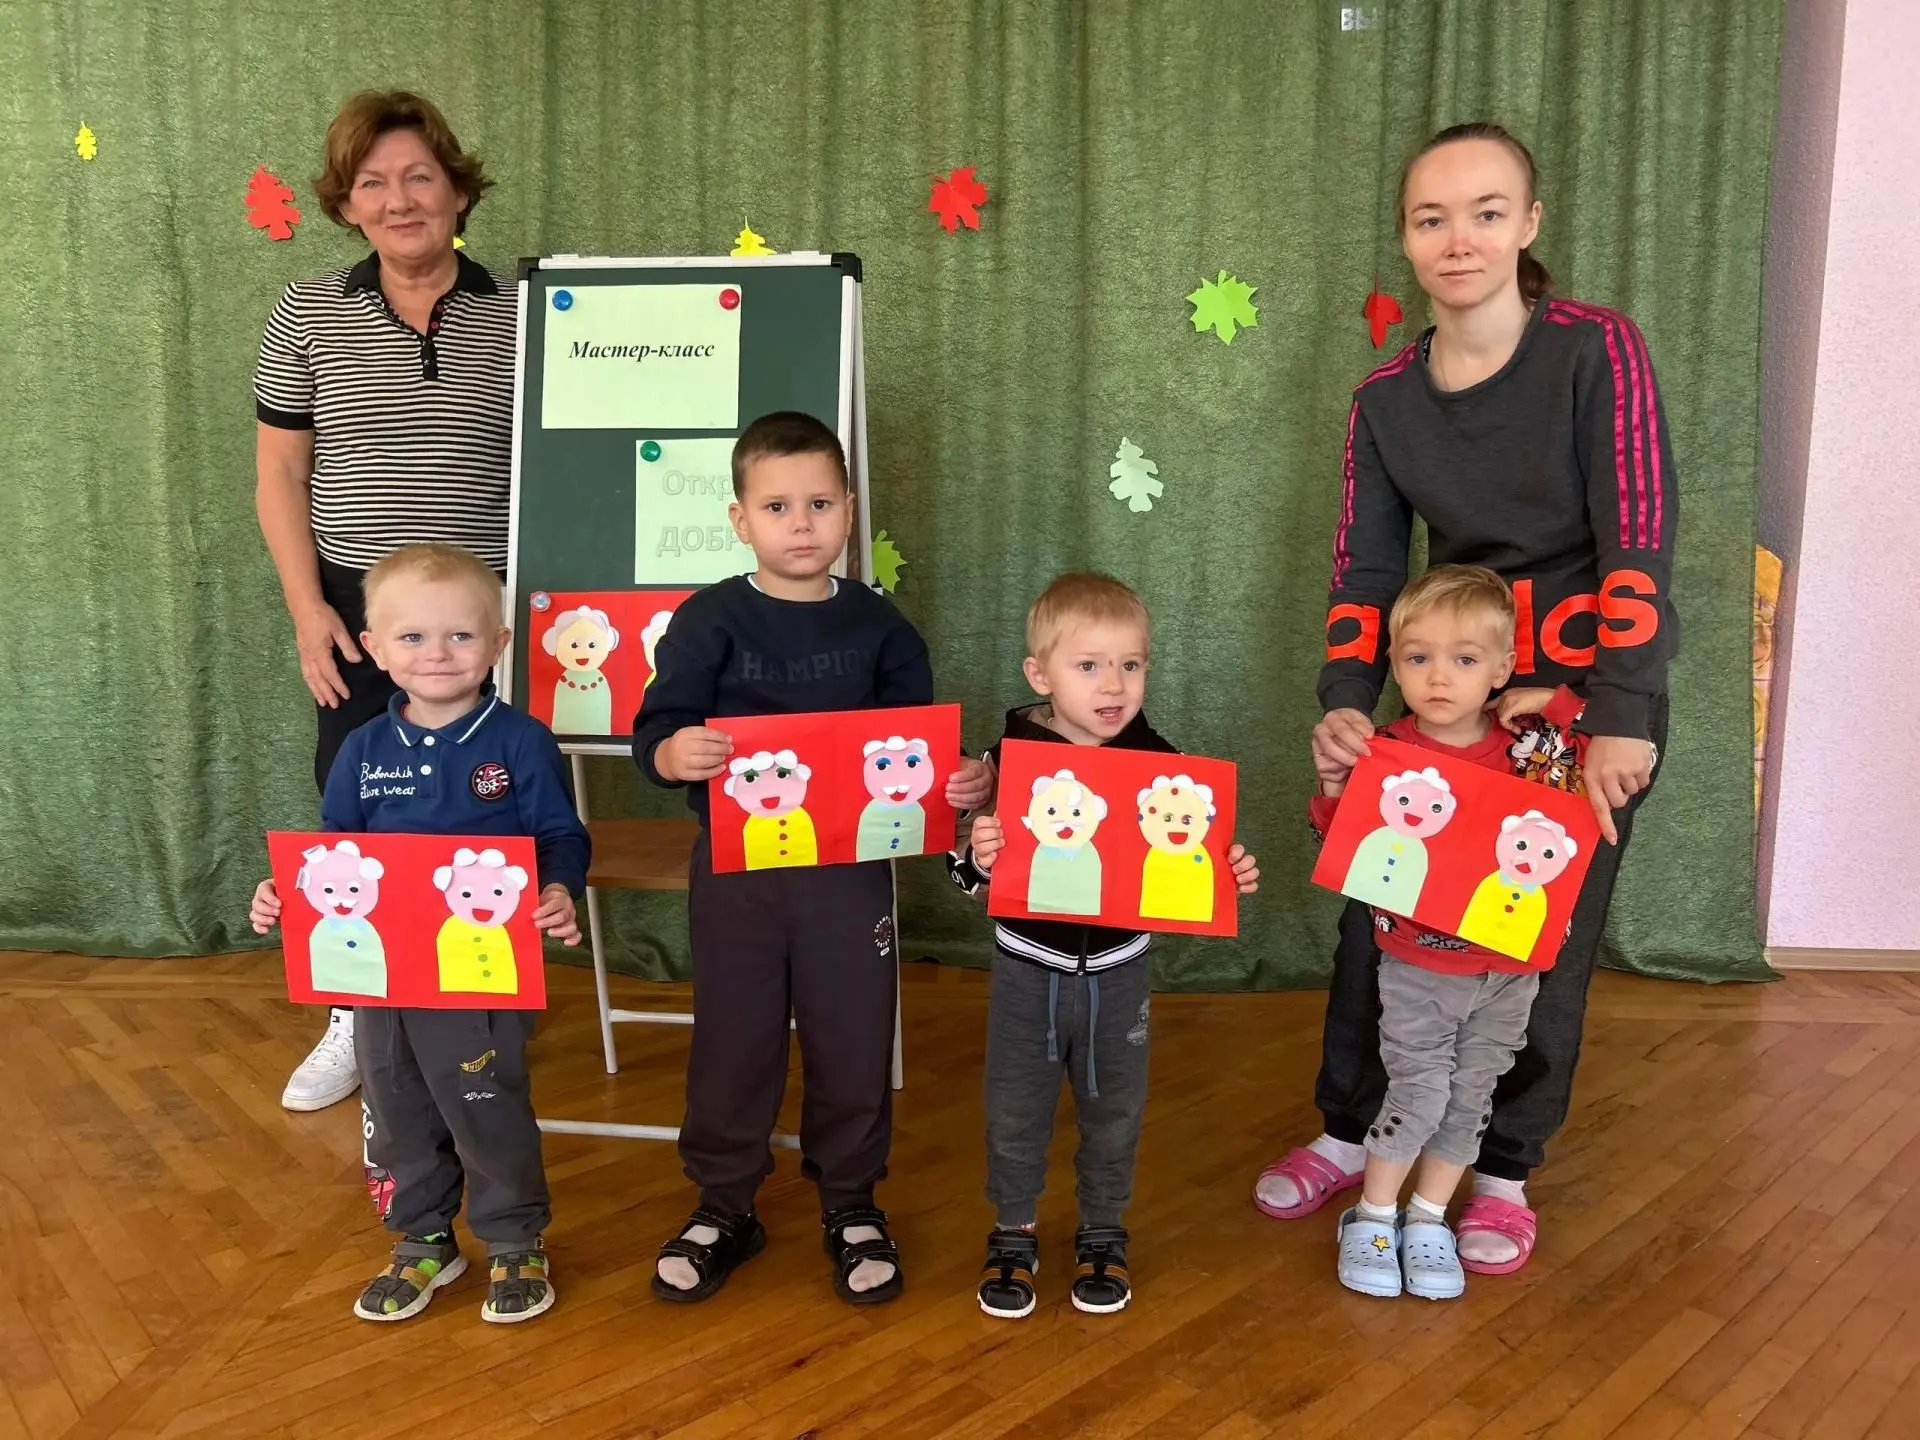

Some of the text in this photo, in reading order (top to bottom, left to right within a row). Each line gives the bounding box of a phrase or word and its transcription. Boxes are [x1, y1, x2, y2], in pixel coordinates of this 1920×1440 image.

[568, 340, 715, 362] Мастер-класс
[661, 468, 734, 501] Откр
[655, 524, 742, 558] ДОБР
